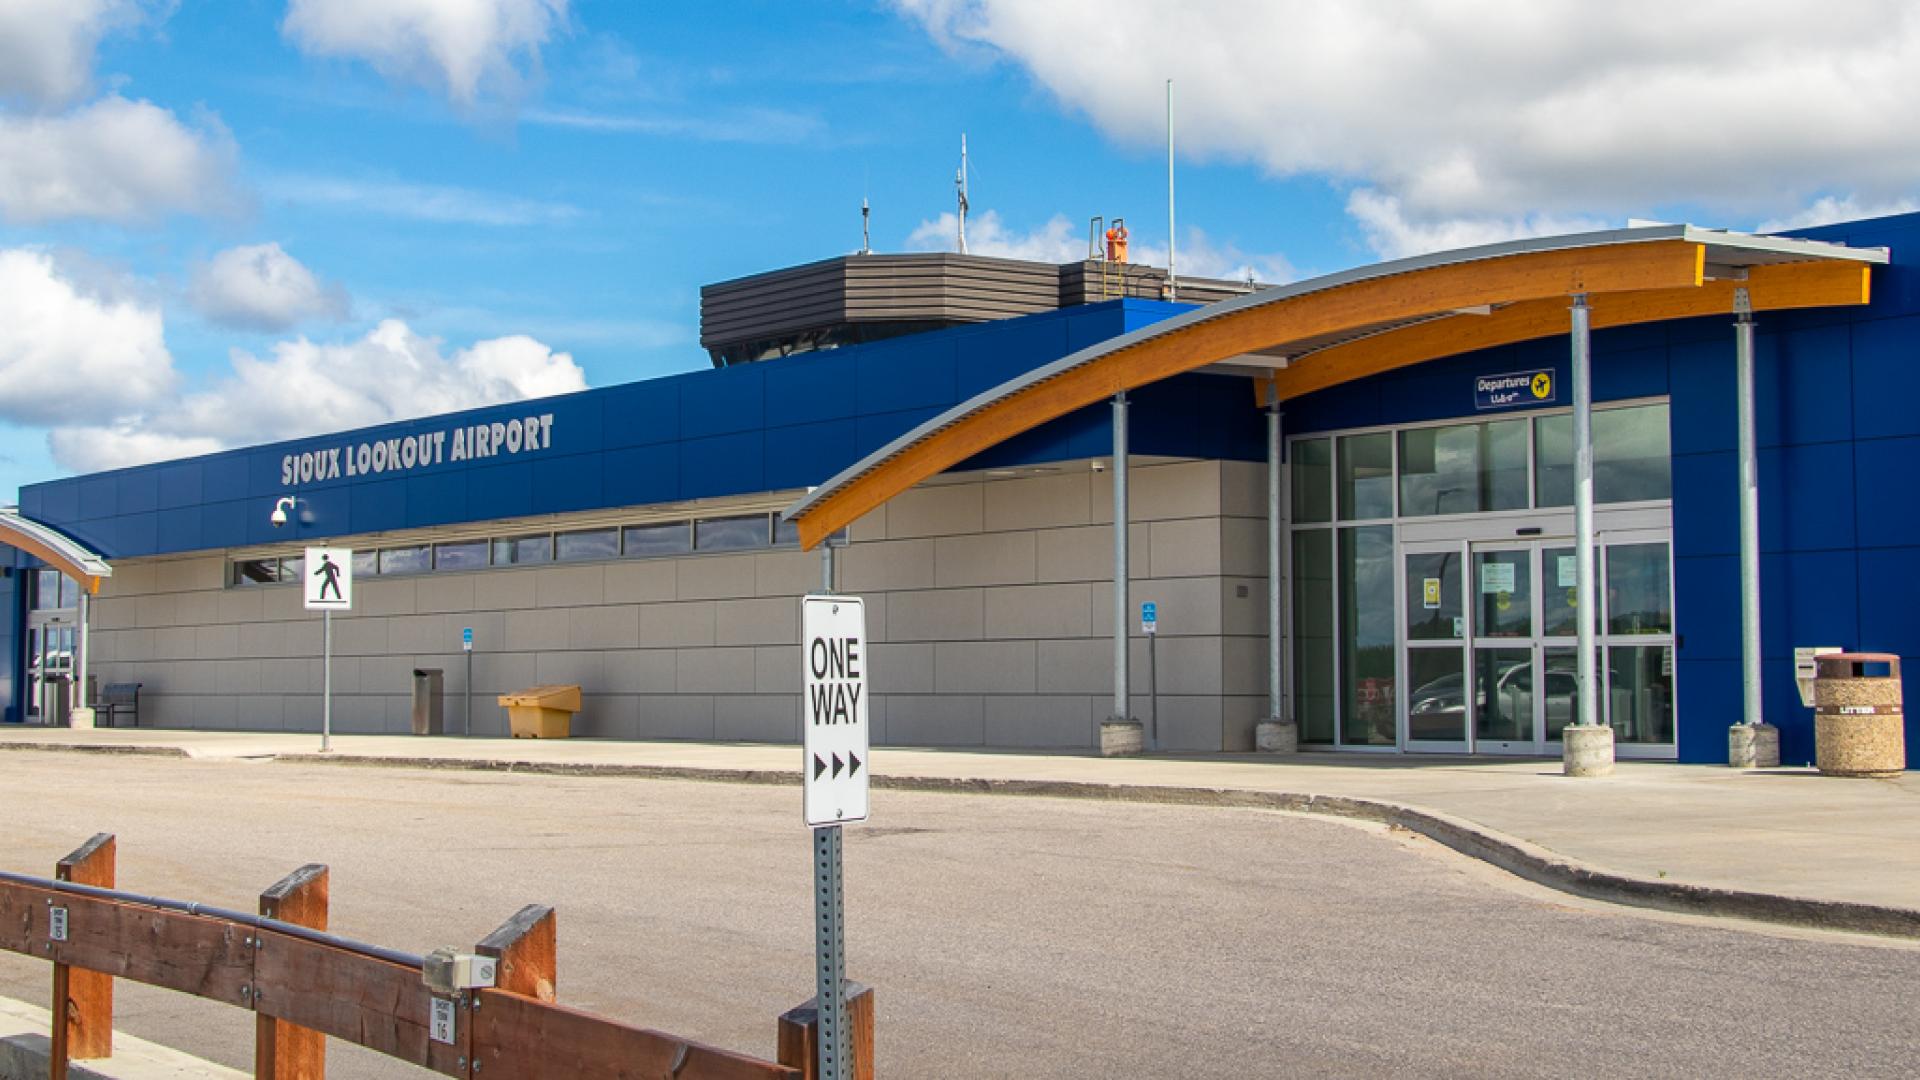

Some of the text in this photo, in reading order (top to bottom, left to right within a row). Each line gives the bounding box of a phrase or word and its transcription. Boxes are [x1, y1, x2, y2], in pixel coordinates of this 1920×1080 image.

[1478, 376, 1530, 393] Departures
[281, 413, 554, 486] SIOUX LOOKOUT AIRPORT
[811, 636, 860, 680] ONE
[810, 682, 861, 725] WAY
[1839, 705, 1875, 714] LITTER
[437, 1022, 448, 1040] 16
